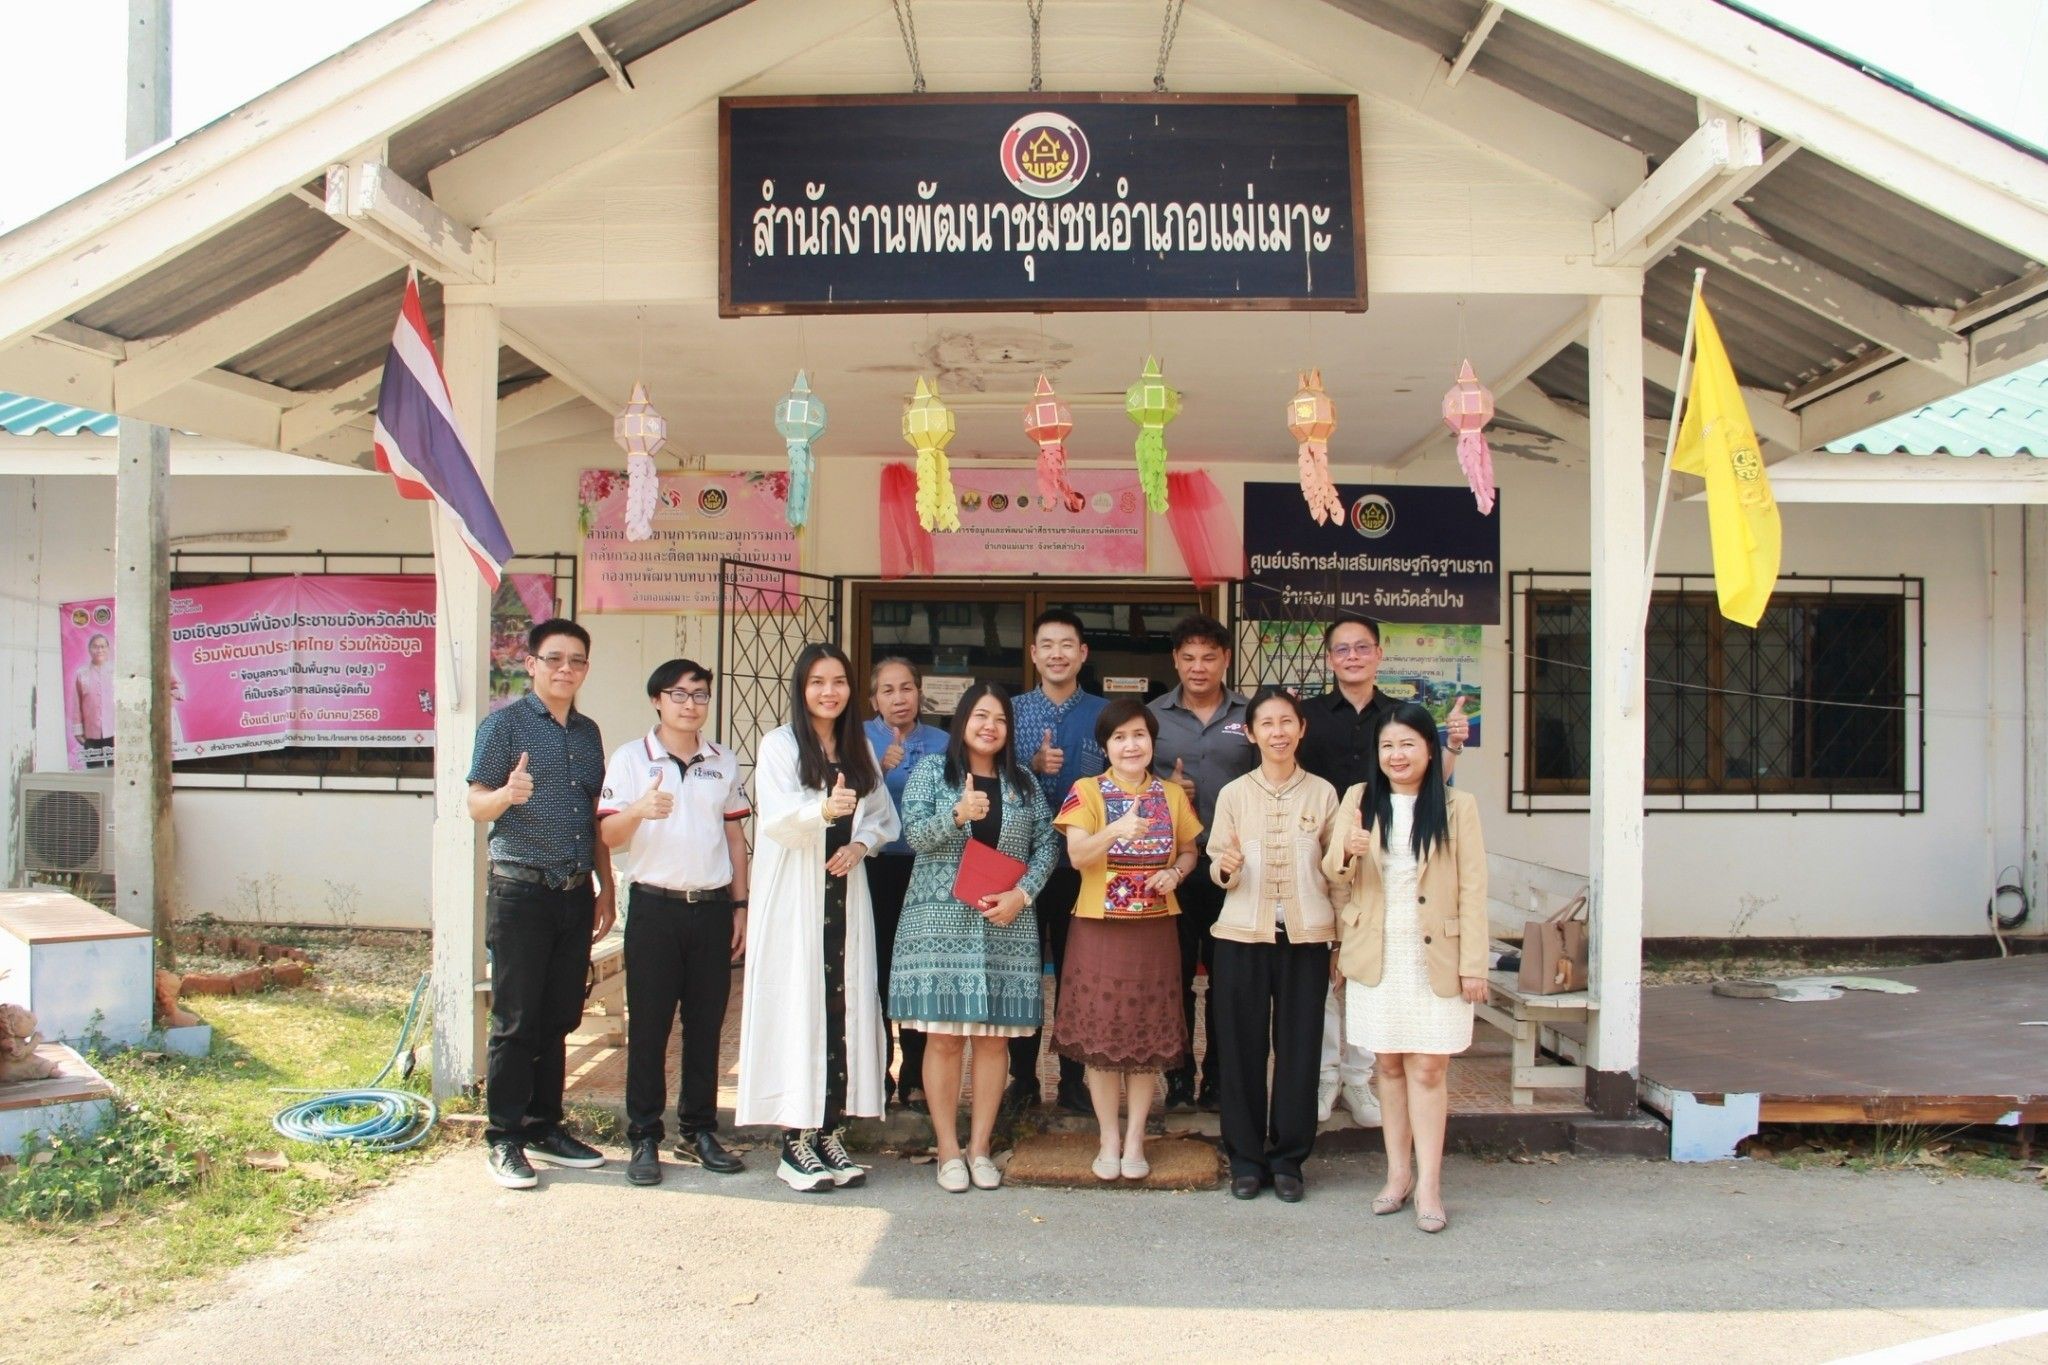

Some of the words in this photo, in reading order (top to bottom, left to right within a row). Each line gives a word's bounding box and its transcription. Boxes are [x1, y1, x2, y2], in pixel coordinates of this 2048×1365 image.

[751, 178, 1331, 283] สำนักงานพัฒนาชุมชนอำเภอแม่เมาะ
[1250, 550, 1493, 577] ศูนย์บริการส่งเสริมเศรษฐกิจฐานราก
[1373, 586, 1464, 608] จังหวัดลำปาง
[338, 634, 422, 657] ร่วมให้ข้อมูล
[351, 709, 380, 721] 2568
